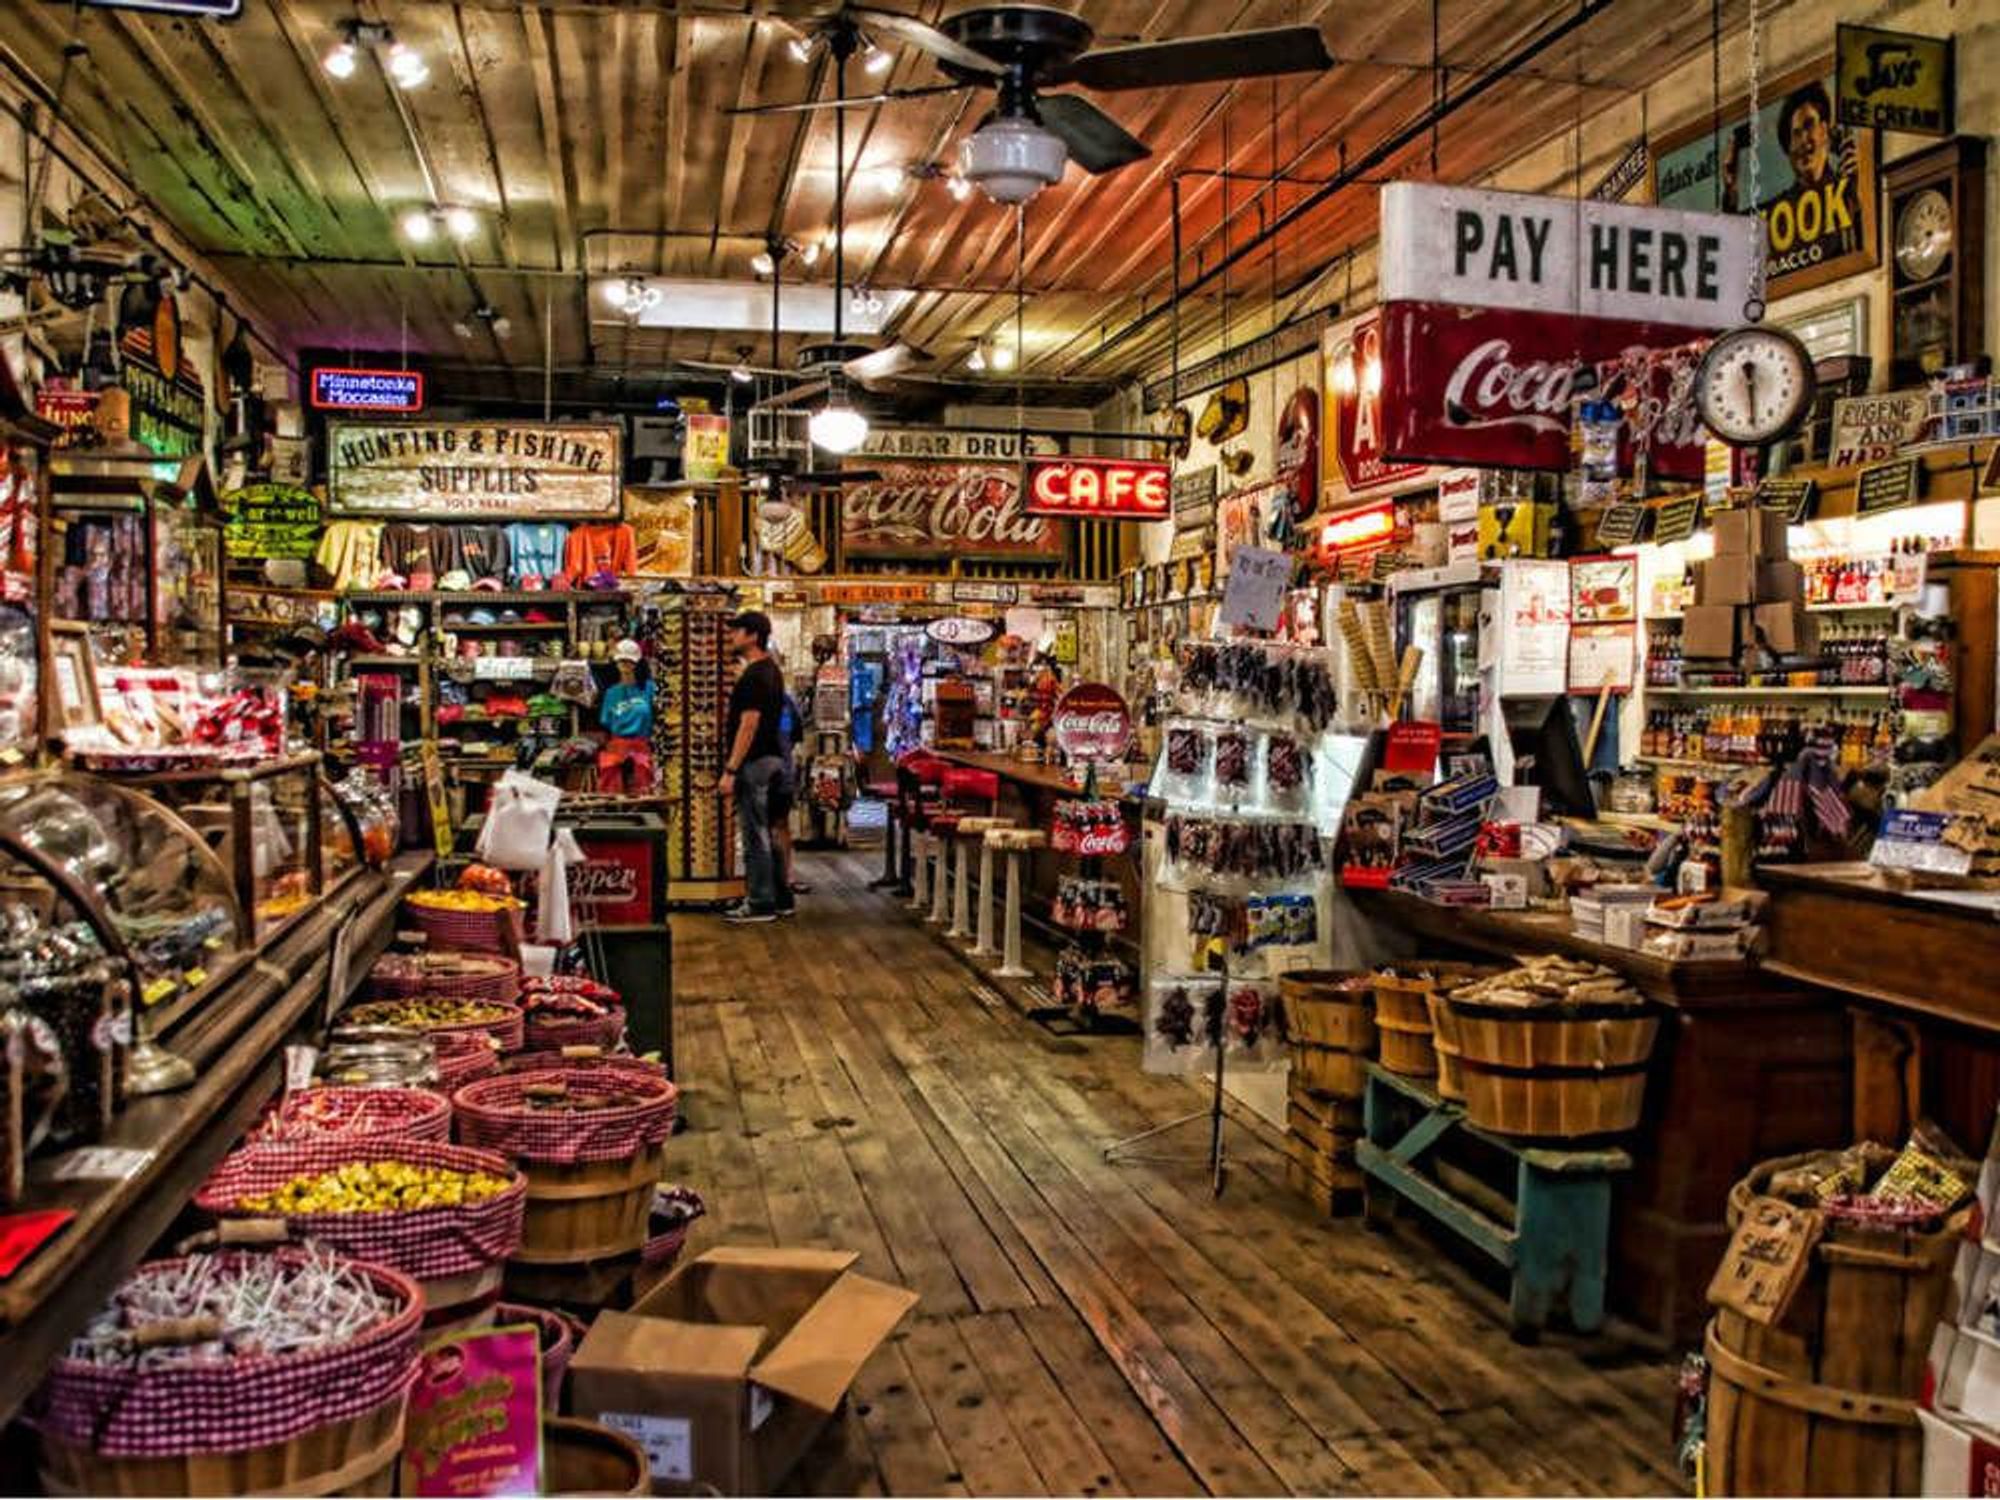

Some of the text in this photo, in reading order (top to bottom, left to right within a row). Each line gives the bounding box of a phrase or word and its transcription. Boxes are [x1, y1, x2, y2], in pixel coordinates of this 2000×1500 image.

[1759, 177, 1852, 252] OOK
[1455, 208, 1720, 300] PAY HERE
[340, 429, 604, 472] HUNTING & FISHING
[420, 466, 538, 493] SUPPLIES
[843, 470, 1048, 542] oca-Cola
[1035, 466, 1166, 506] CAFE
